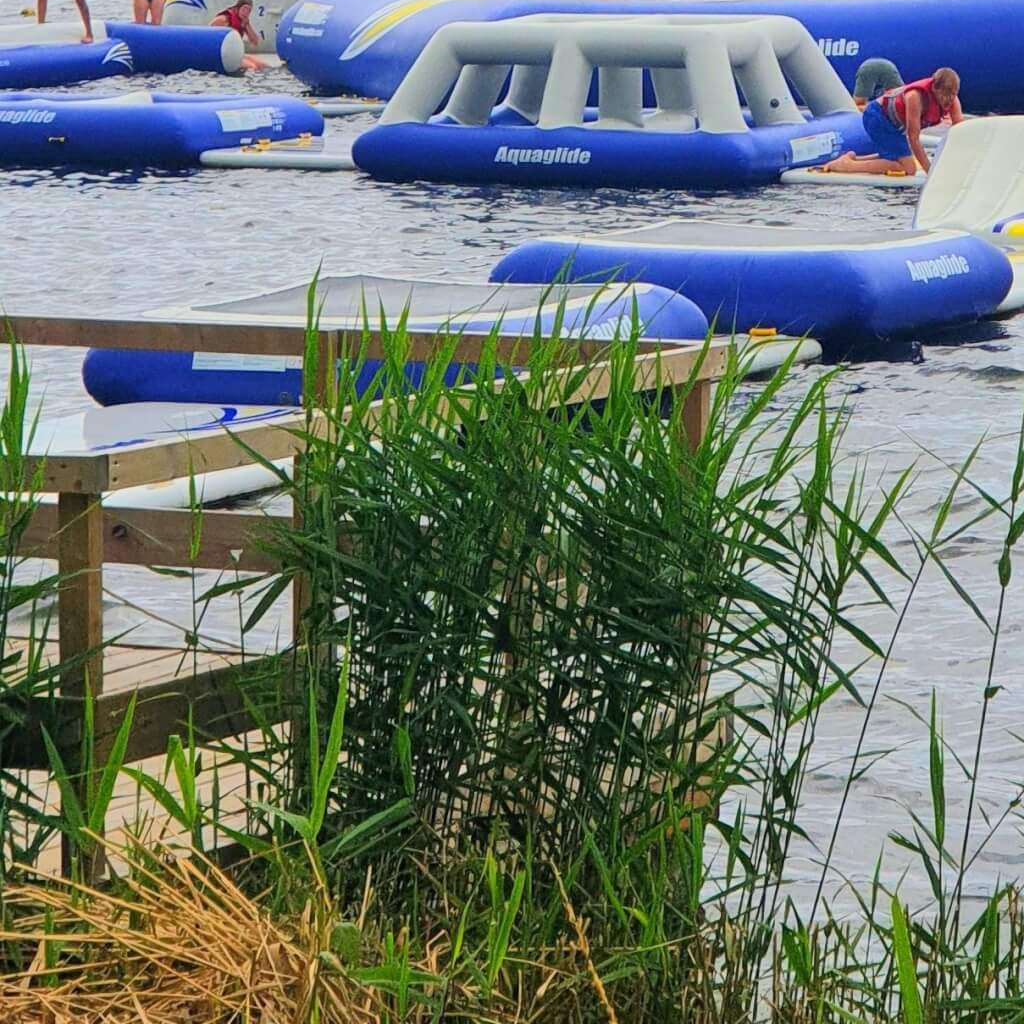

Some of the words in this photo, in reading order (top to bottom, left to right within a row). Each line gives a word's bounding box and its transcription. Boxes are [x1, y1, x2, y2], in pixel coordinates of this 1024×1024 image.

[258, 6, 265, 16] 2
[494, 145, 592, 166] Aquaglide
[904, 253, 969, 284] Aquaglide
